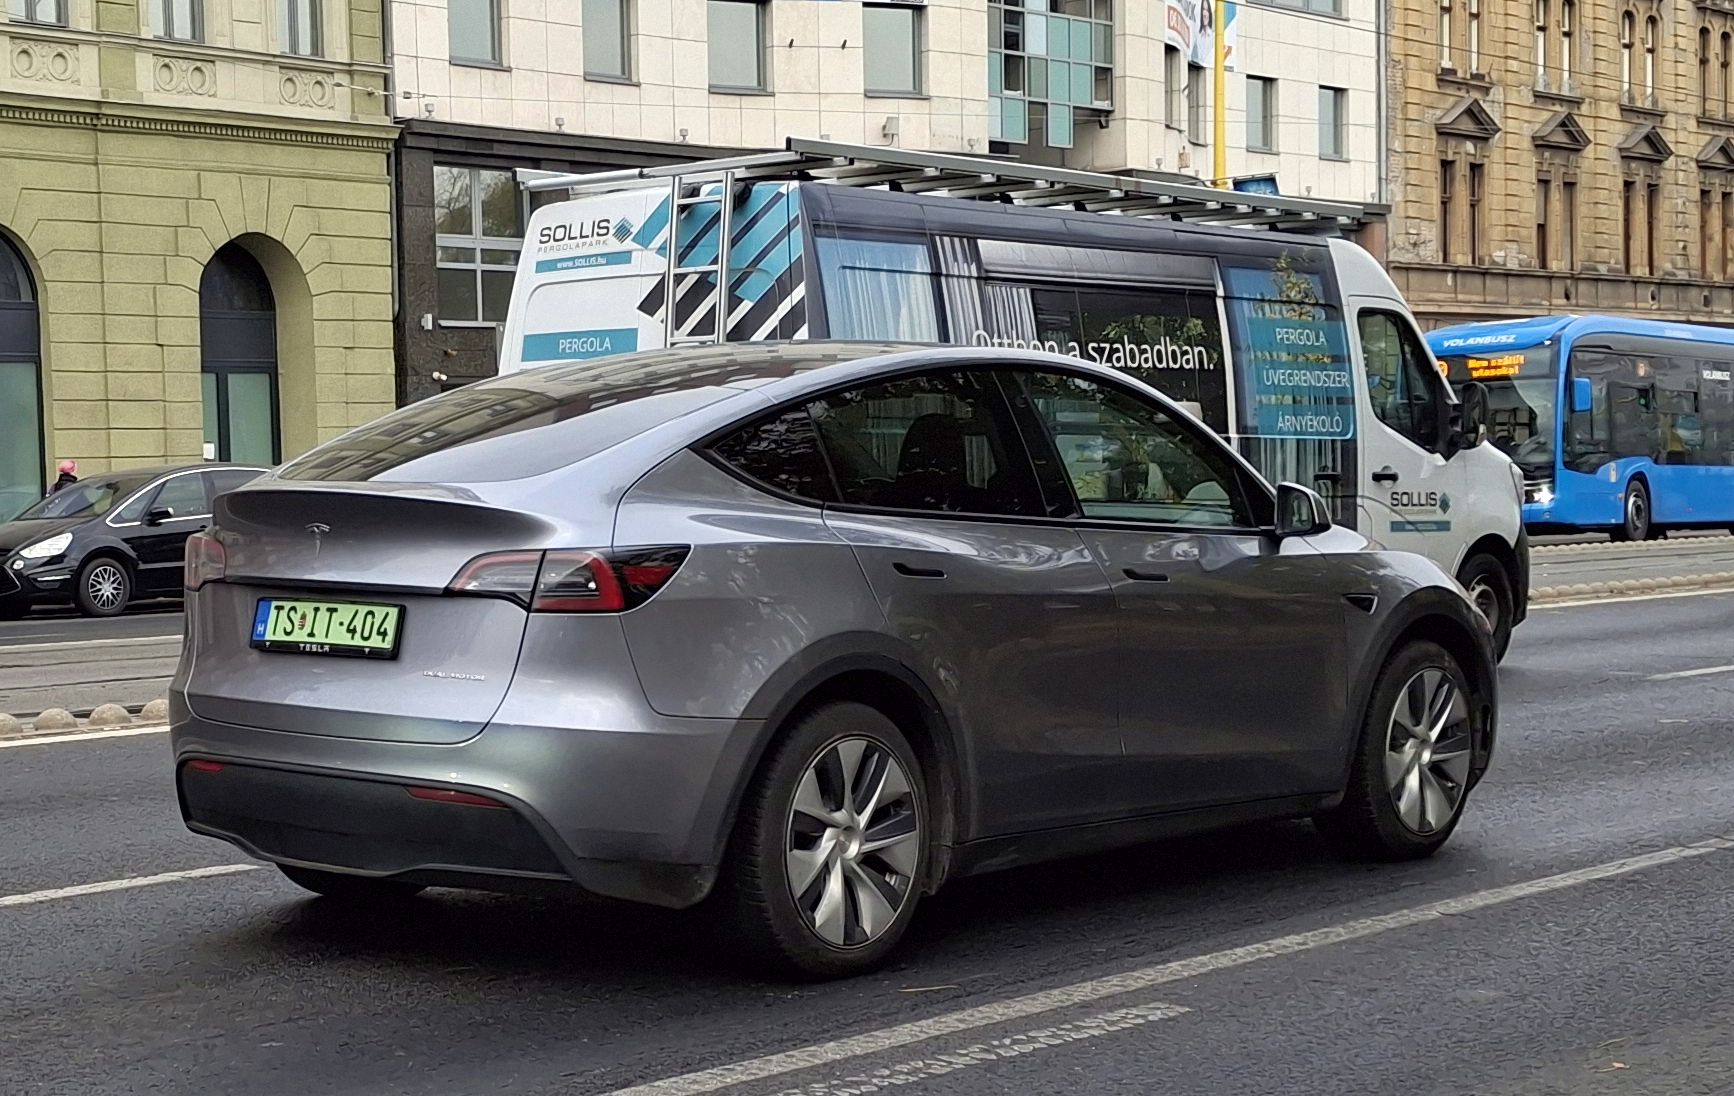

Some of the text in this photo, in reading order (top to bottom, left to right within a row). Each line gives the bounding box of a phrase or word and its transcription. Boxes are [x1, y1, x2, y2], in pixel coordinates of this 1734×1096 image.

[539, 218, 611, 245] SOLLIS
[559, 337, 611, 353] PERGOLA
[1275, 327, 1327, 346] PERGOLA
[1088, 335, 1214, 370] szabadban.
[1277, 411, 1342, 433] ÁRNYÉKOLÓ
[1390, 491, 1438, 507] SOLLIS
[256, 623, 265, 635] H
[299, 643, 331, 653] TESLA
